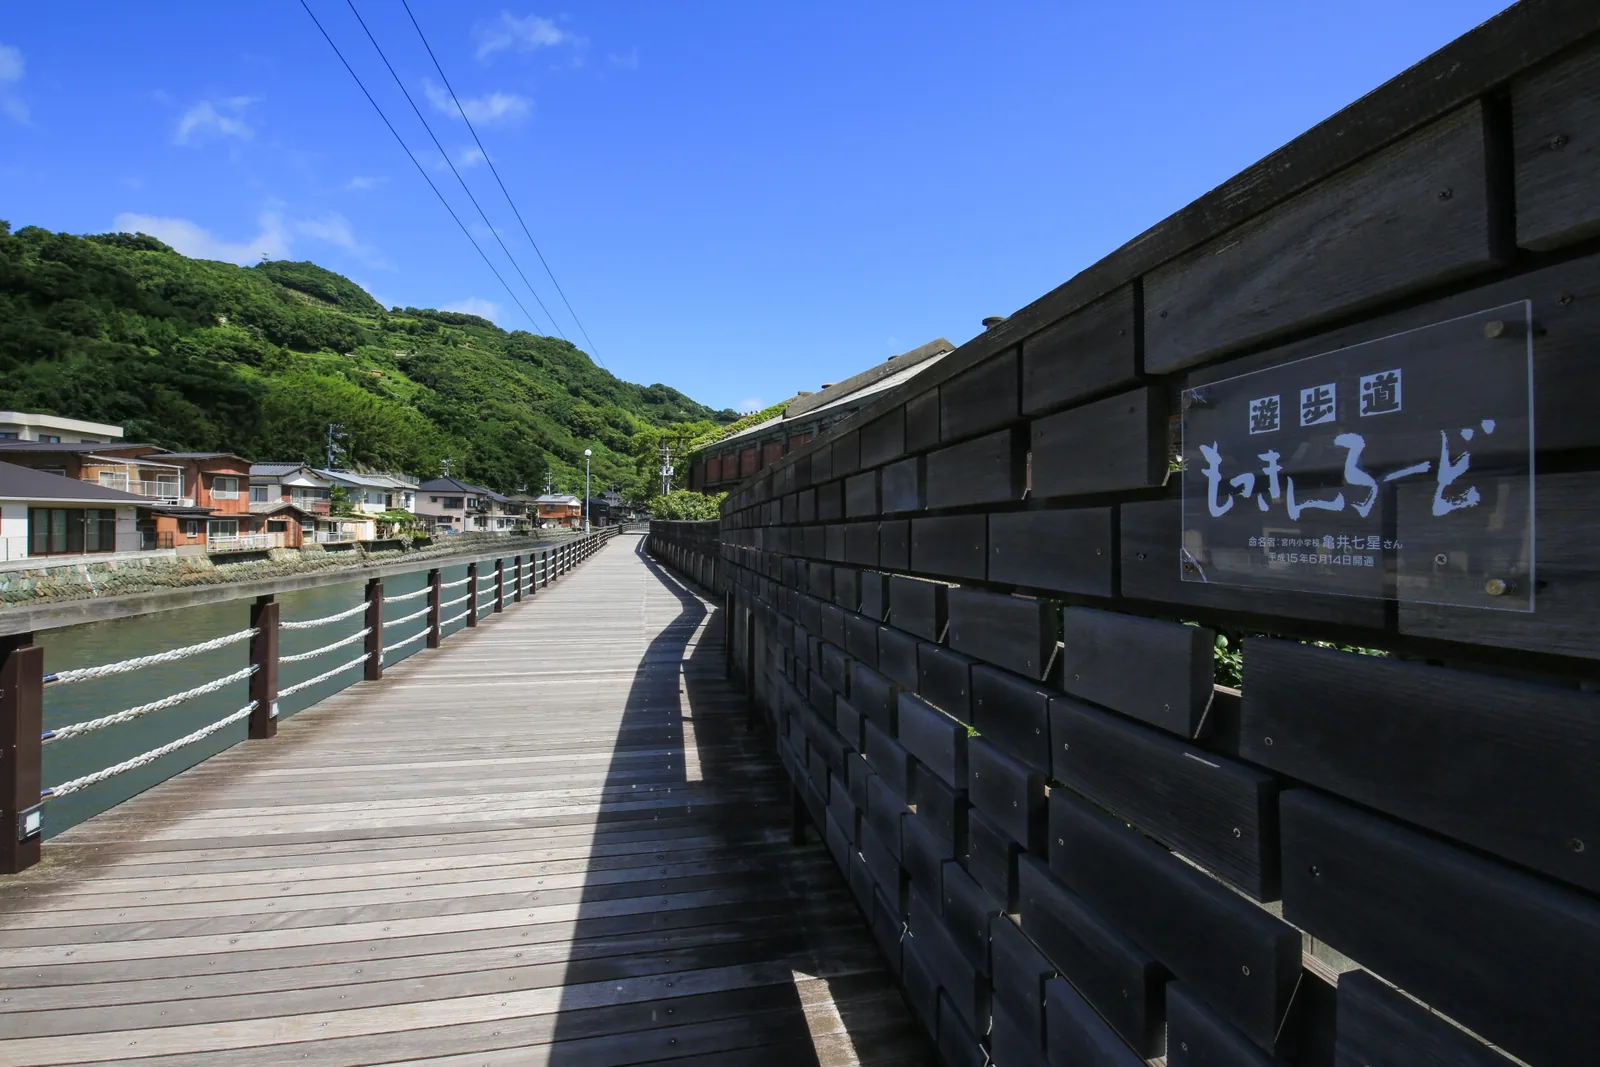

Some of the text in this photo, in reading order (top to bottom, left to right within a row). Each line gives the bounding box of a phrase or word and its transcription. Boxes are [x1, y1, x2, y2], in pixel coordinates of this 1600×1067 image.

[1250, 369, 1402, 434] 遊歩道
[1200, 419, 1496, 520] もっきんろーど
[1268, 553, 1375, 567] 平成15年6月14日開通
